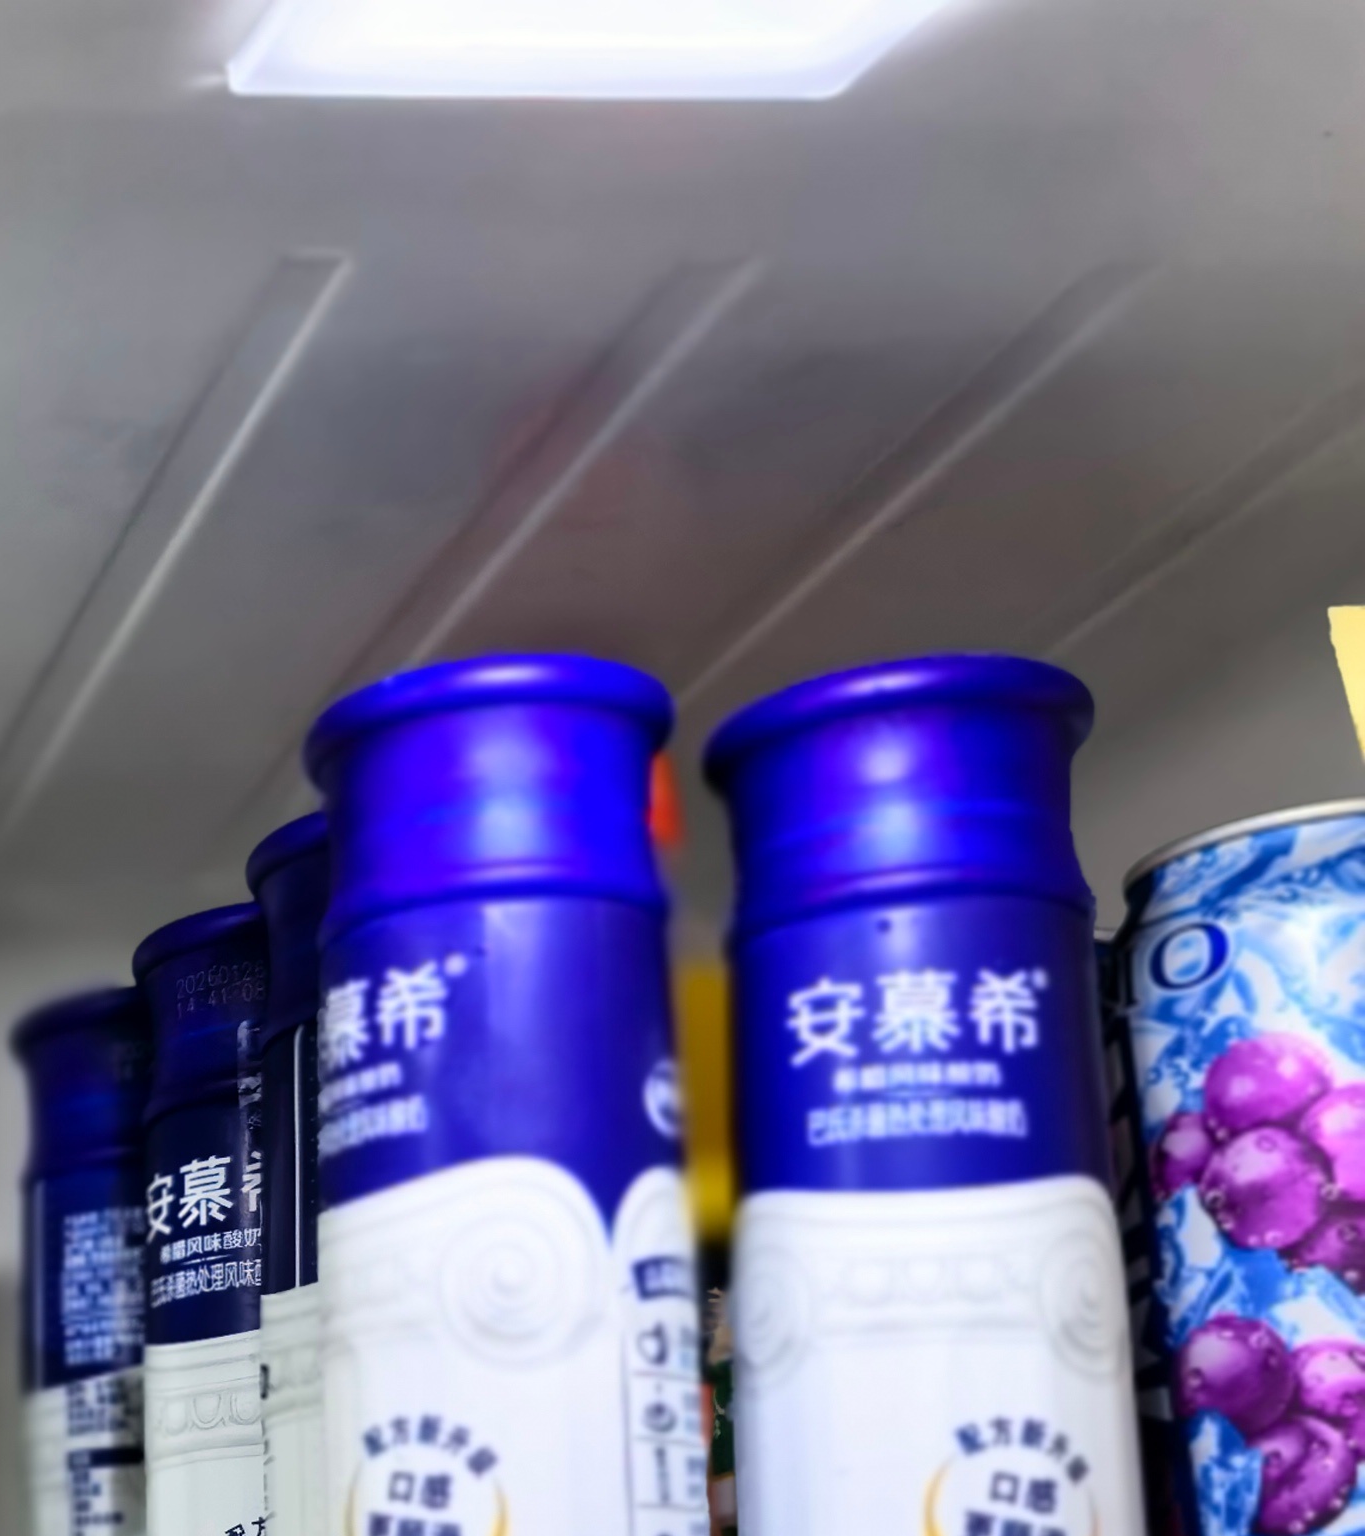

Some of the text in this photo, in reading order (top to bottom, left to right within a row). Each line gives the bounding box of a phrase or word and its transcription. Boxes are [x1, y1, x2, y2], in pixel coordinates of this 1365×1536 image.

[786, 967, 1038, 1068] 安慕希
[387, 1470, 453, 1512] 口感
[989, 1470, 1058, 1516] 口感
